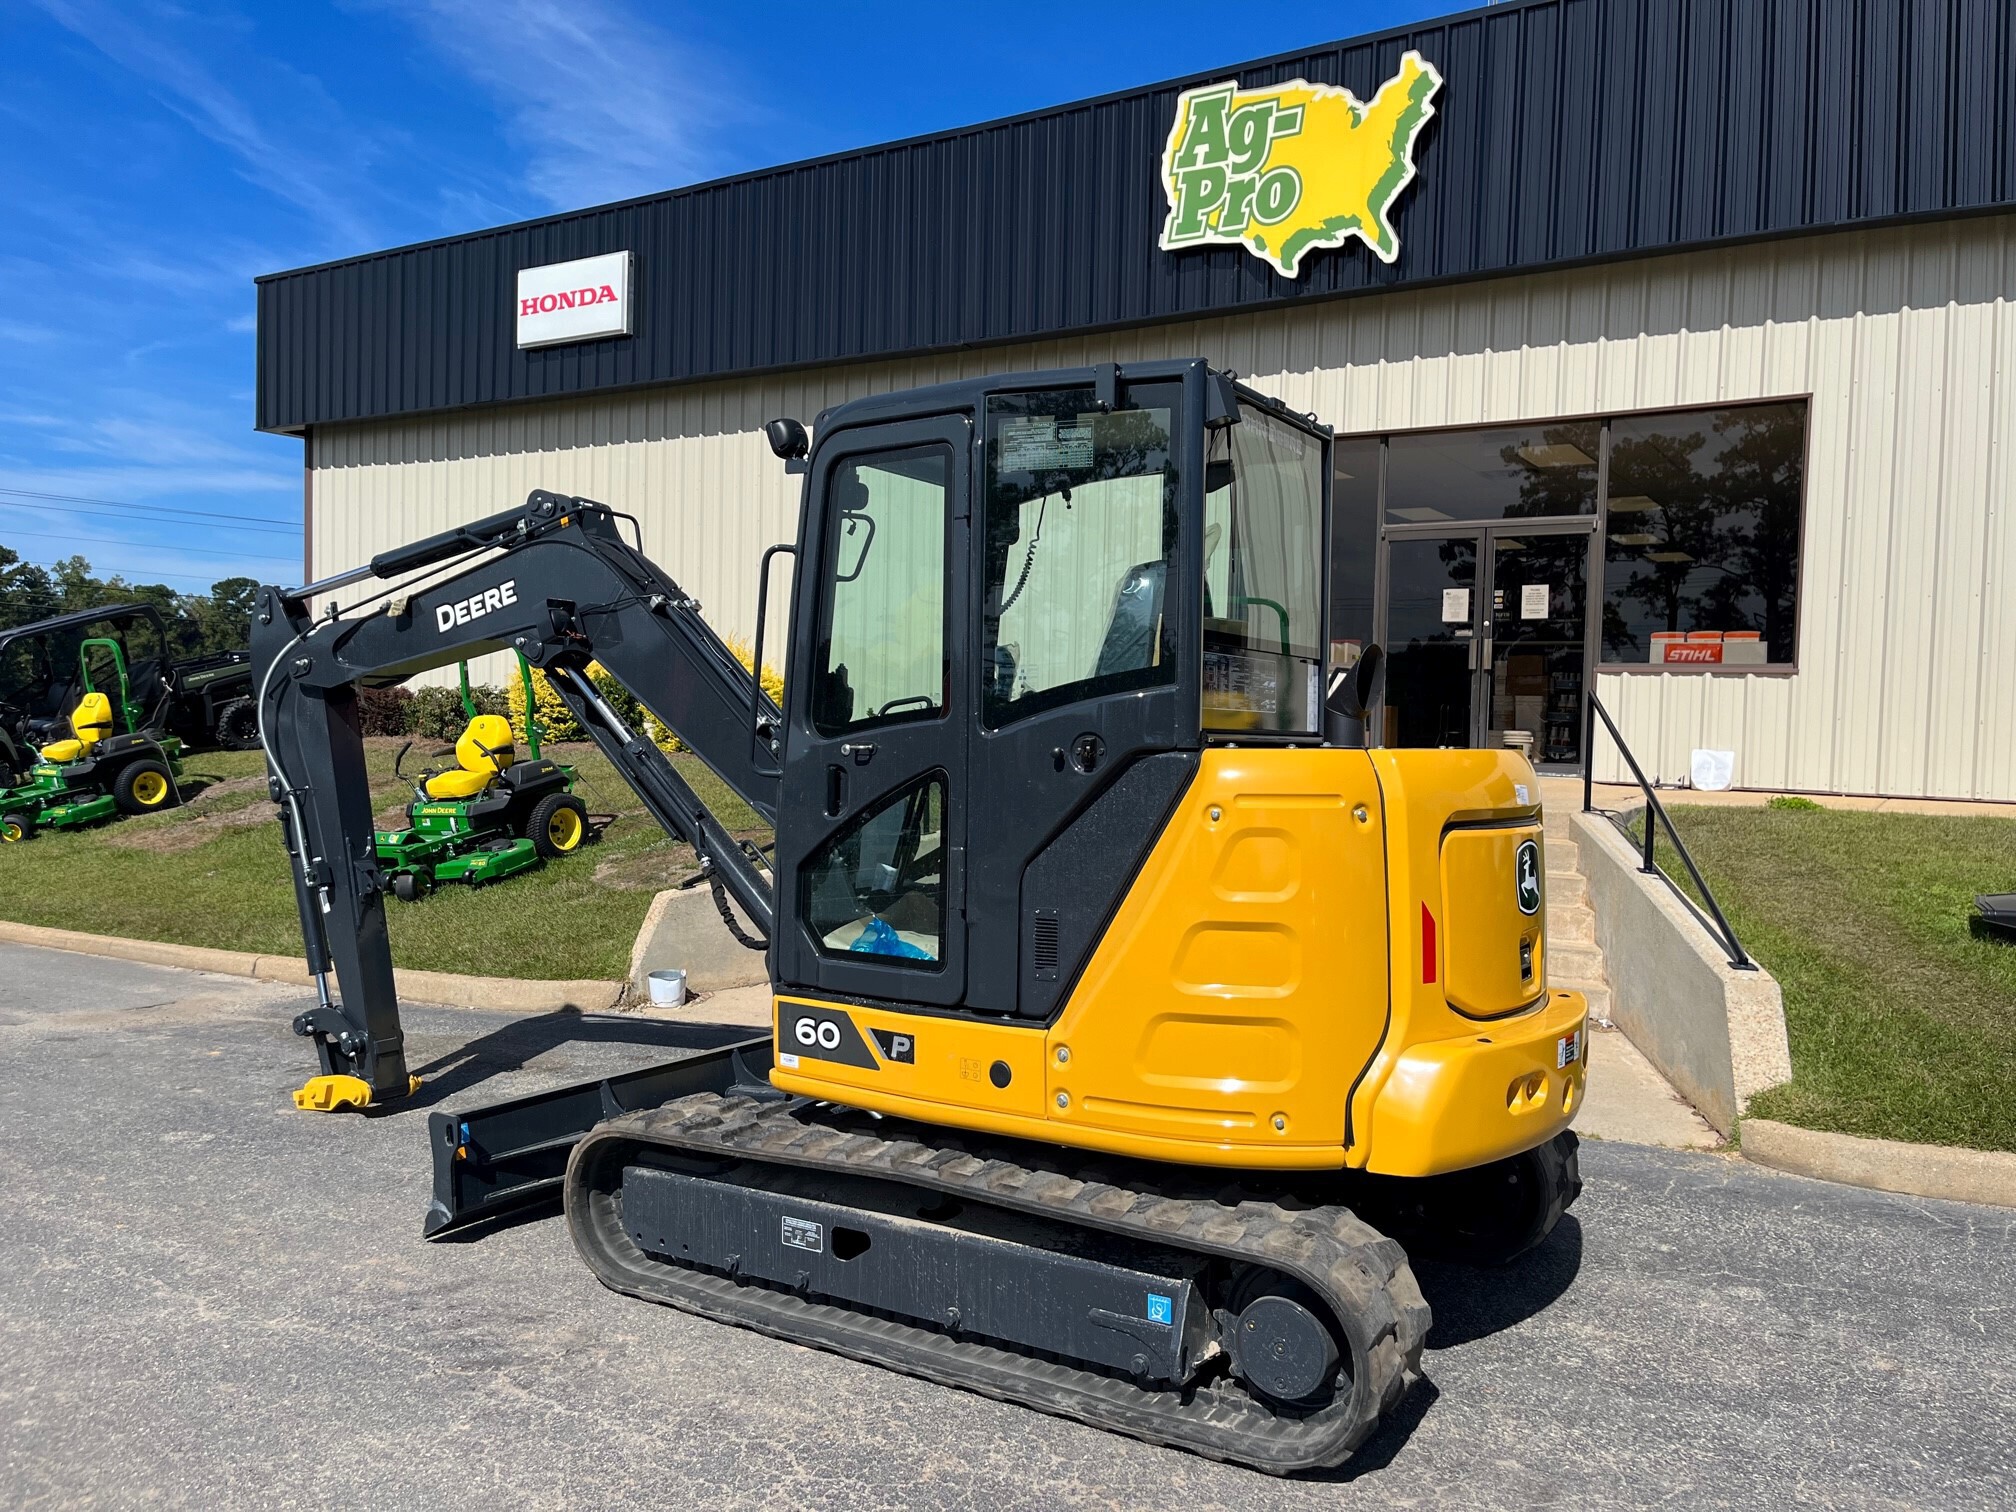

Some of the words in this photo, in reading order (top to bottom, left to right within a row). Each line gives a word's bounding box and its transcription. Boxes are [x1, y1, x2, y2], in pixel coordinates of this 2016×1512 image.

[1172, 90, 1304, 176] Ag-
[1169, 165, 1302, 240] Pro
[520, 284, 618, 316] HONDA
[435, 579, 518, 633] DEERE
[1667, 649, 1715, 661] STIHL
[795, 1017, 841, 1050] 60
[891, 1035, 911, 1058] P
